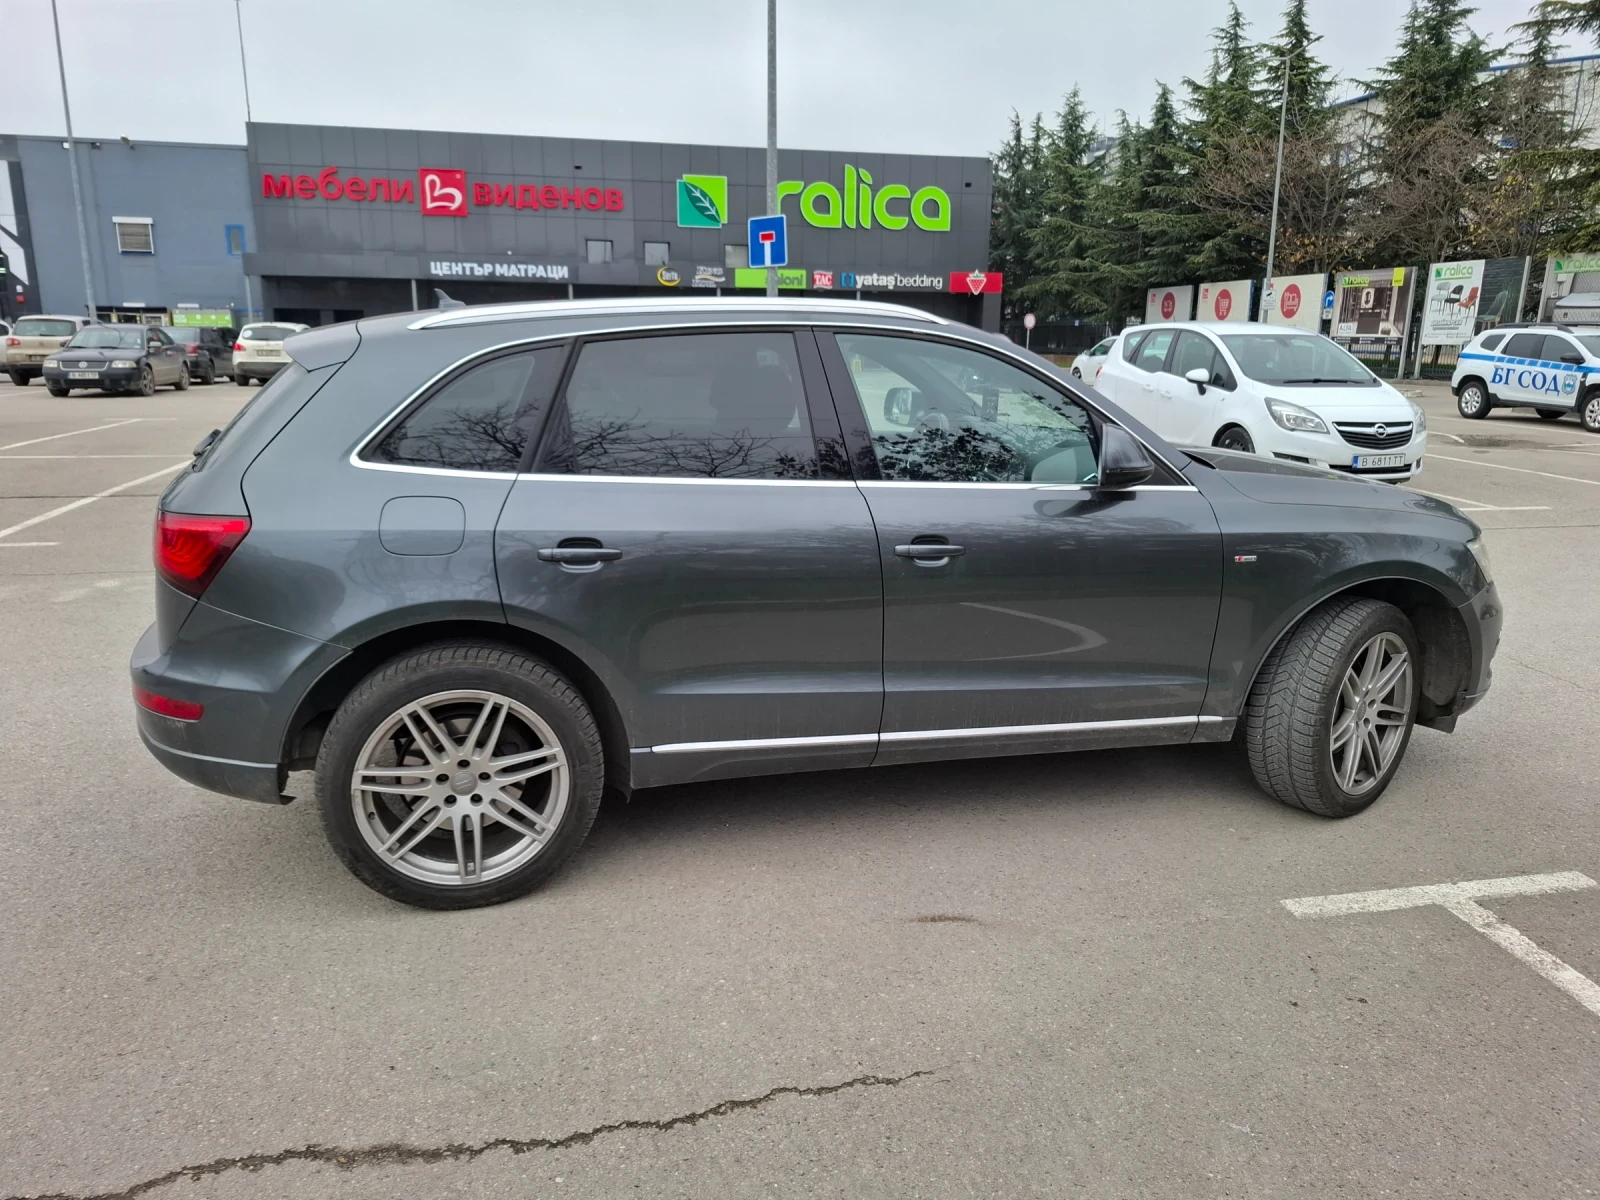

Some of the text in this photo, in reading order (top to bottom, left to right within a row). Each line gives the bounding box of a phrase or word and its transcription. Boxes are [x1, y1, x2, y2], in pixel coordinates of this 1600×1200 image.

[262, 165, 624, 211] мебели виденов
[777, 163, 951, 231] ralica
[430, 261, 569, 280] ЦЕНТЪР МАТРАЦИ
[1444, 263, 1473, 276] ralica
[814, 273, 832, 285] TAC
[897, 274, 943, 290] bedding
[1349, 274, 1370, 284] ralica
[1490, 364, 1560, 396] БГ СОД
[1362, 456, 1404, 466] B 6811 TT
